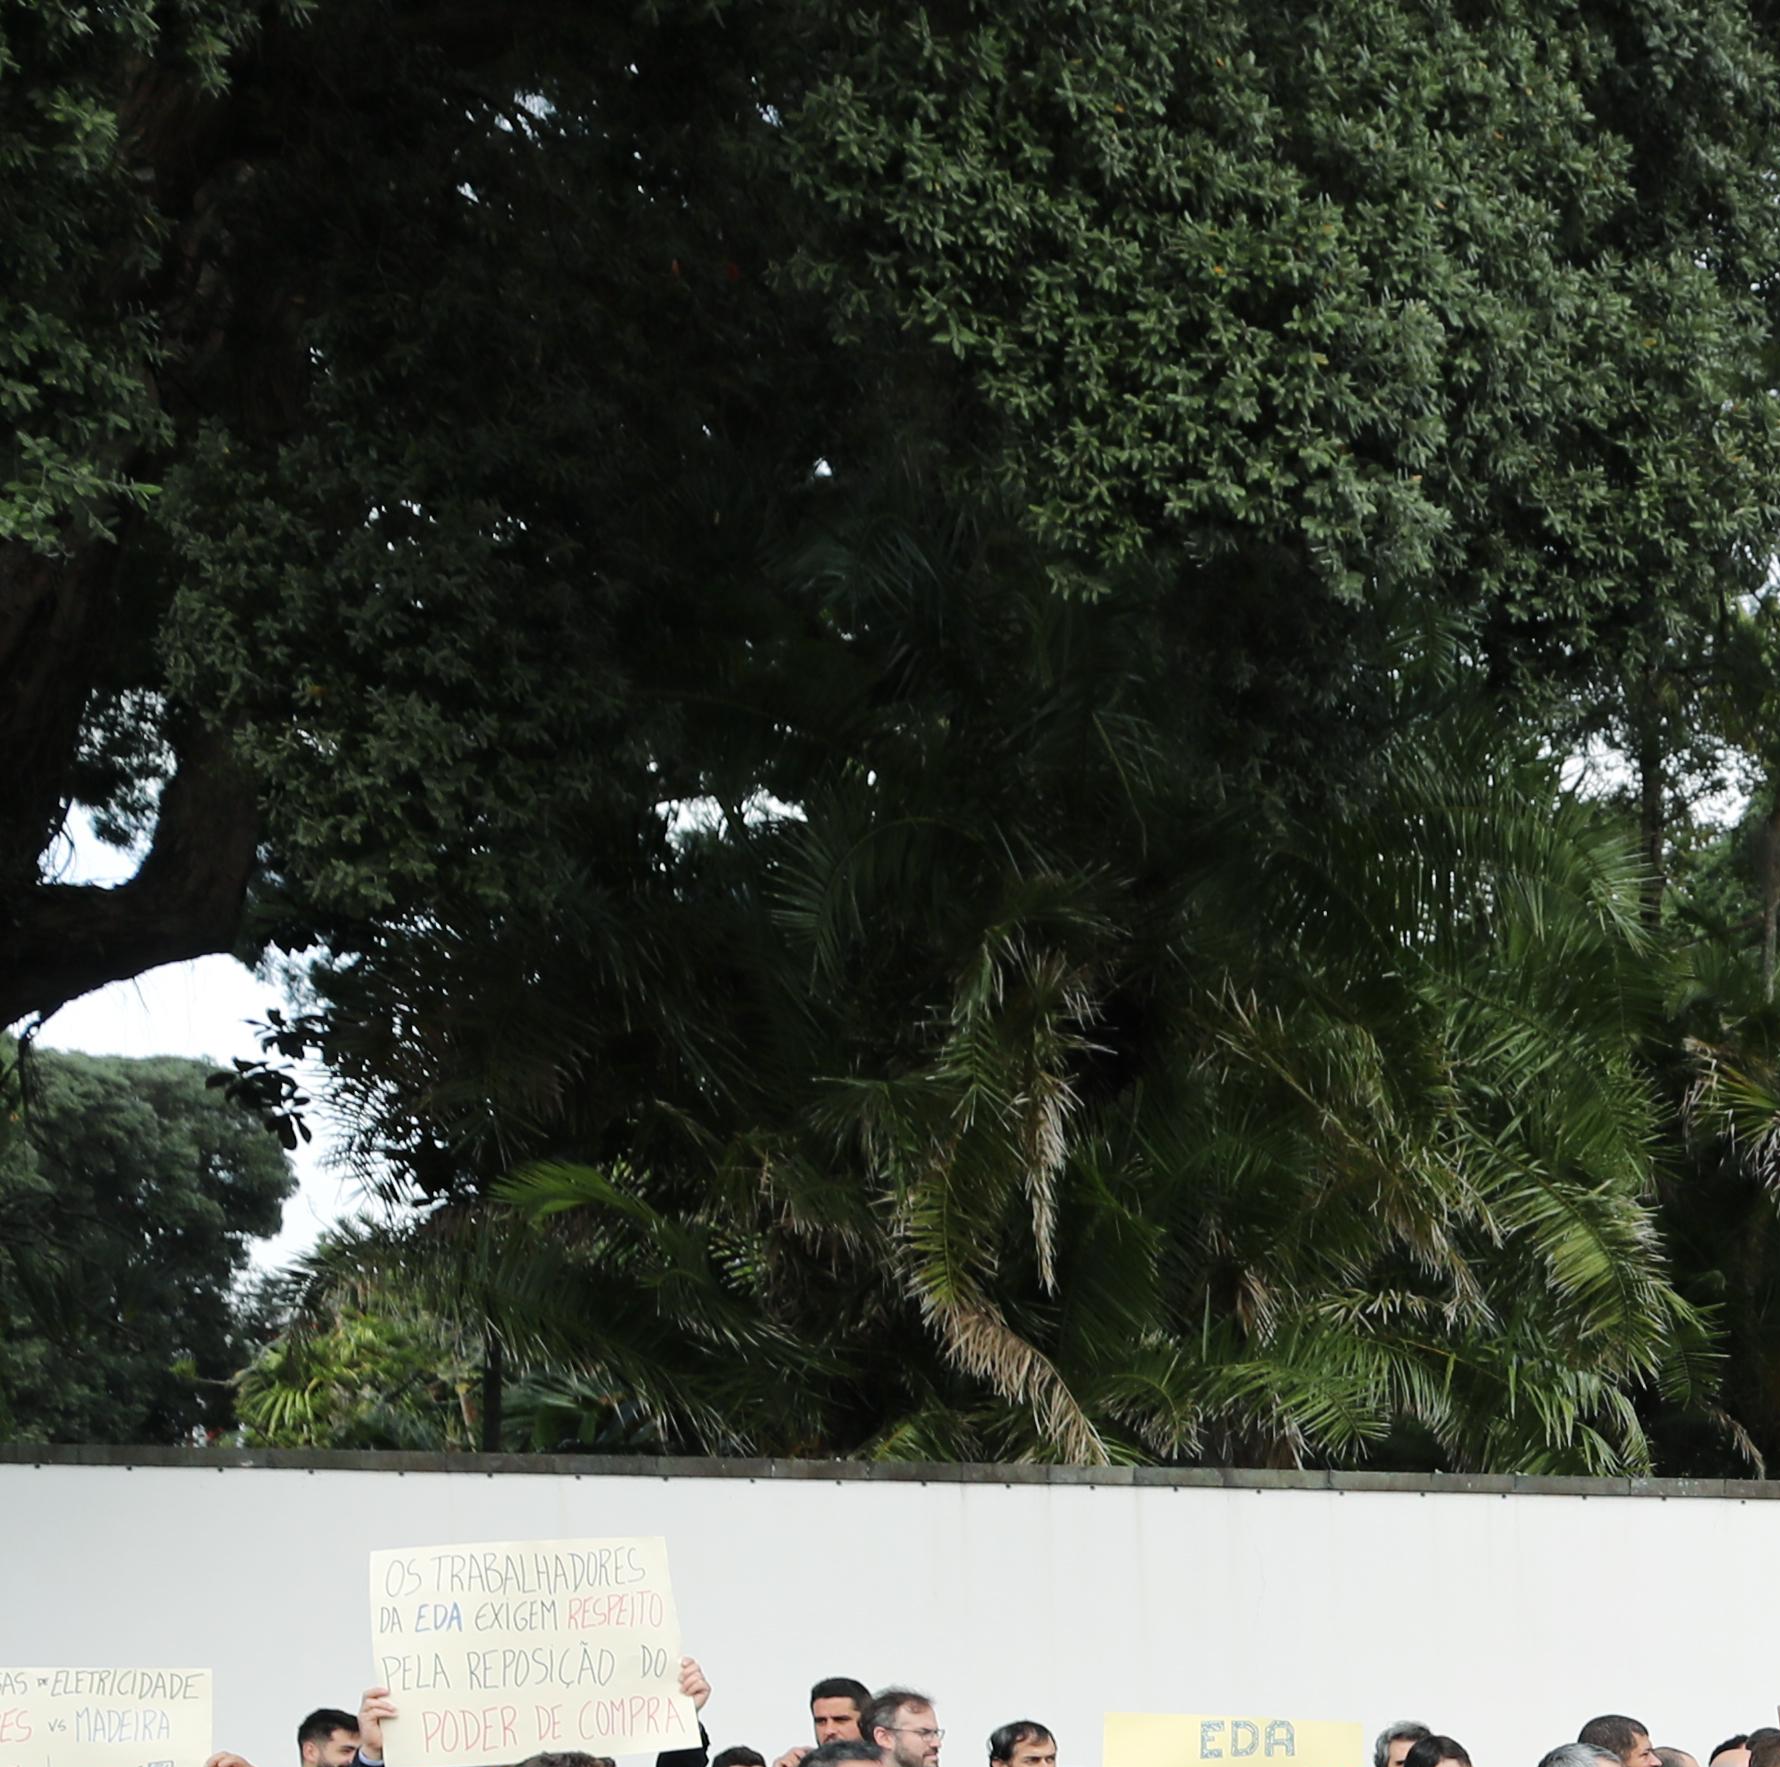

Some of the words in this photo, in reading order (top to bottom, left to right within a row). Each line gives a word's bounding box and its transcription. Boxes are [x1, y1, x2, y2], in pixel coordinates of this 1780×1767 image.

[386, 1557, 421, 1598] OS
[430, 1546, 646, 1595] TRABALHADORES
[380, 1605, 403, 1634] DA
[415, 1601, 463, 1633] EDA
[475, 1597, 558, 1632] EXIGEM
[568, 1590, 664, 1629] RESPEITO
[0, 1671, 28, 1696] AS
[51, 1669, 205, 1700] ELETRICIDADE
[382, 1652, 450, 1692] PELA
[466, 1641, 616, 1690] REPOSIÇÃO
[641, 1644, 668, 1679] DO
[75, 1706, 170, 1743] MADEIRA
[422, 1705, 519, 1754] PODER
[535, 1703, 563, 1742] DE
[579, 1695, 686, 1741] COMPRA
[1199, 1719, 1296, 1759] EDA
